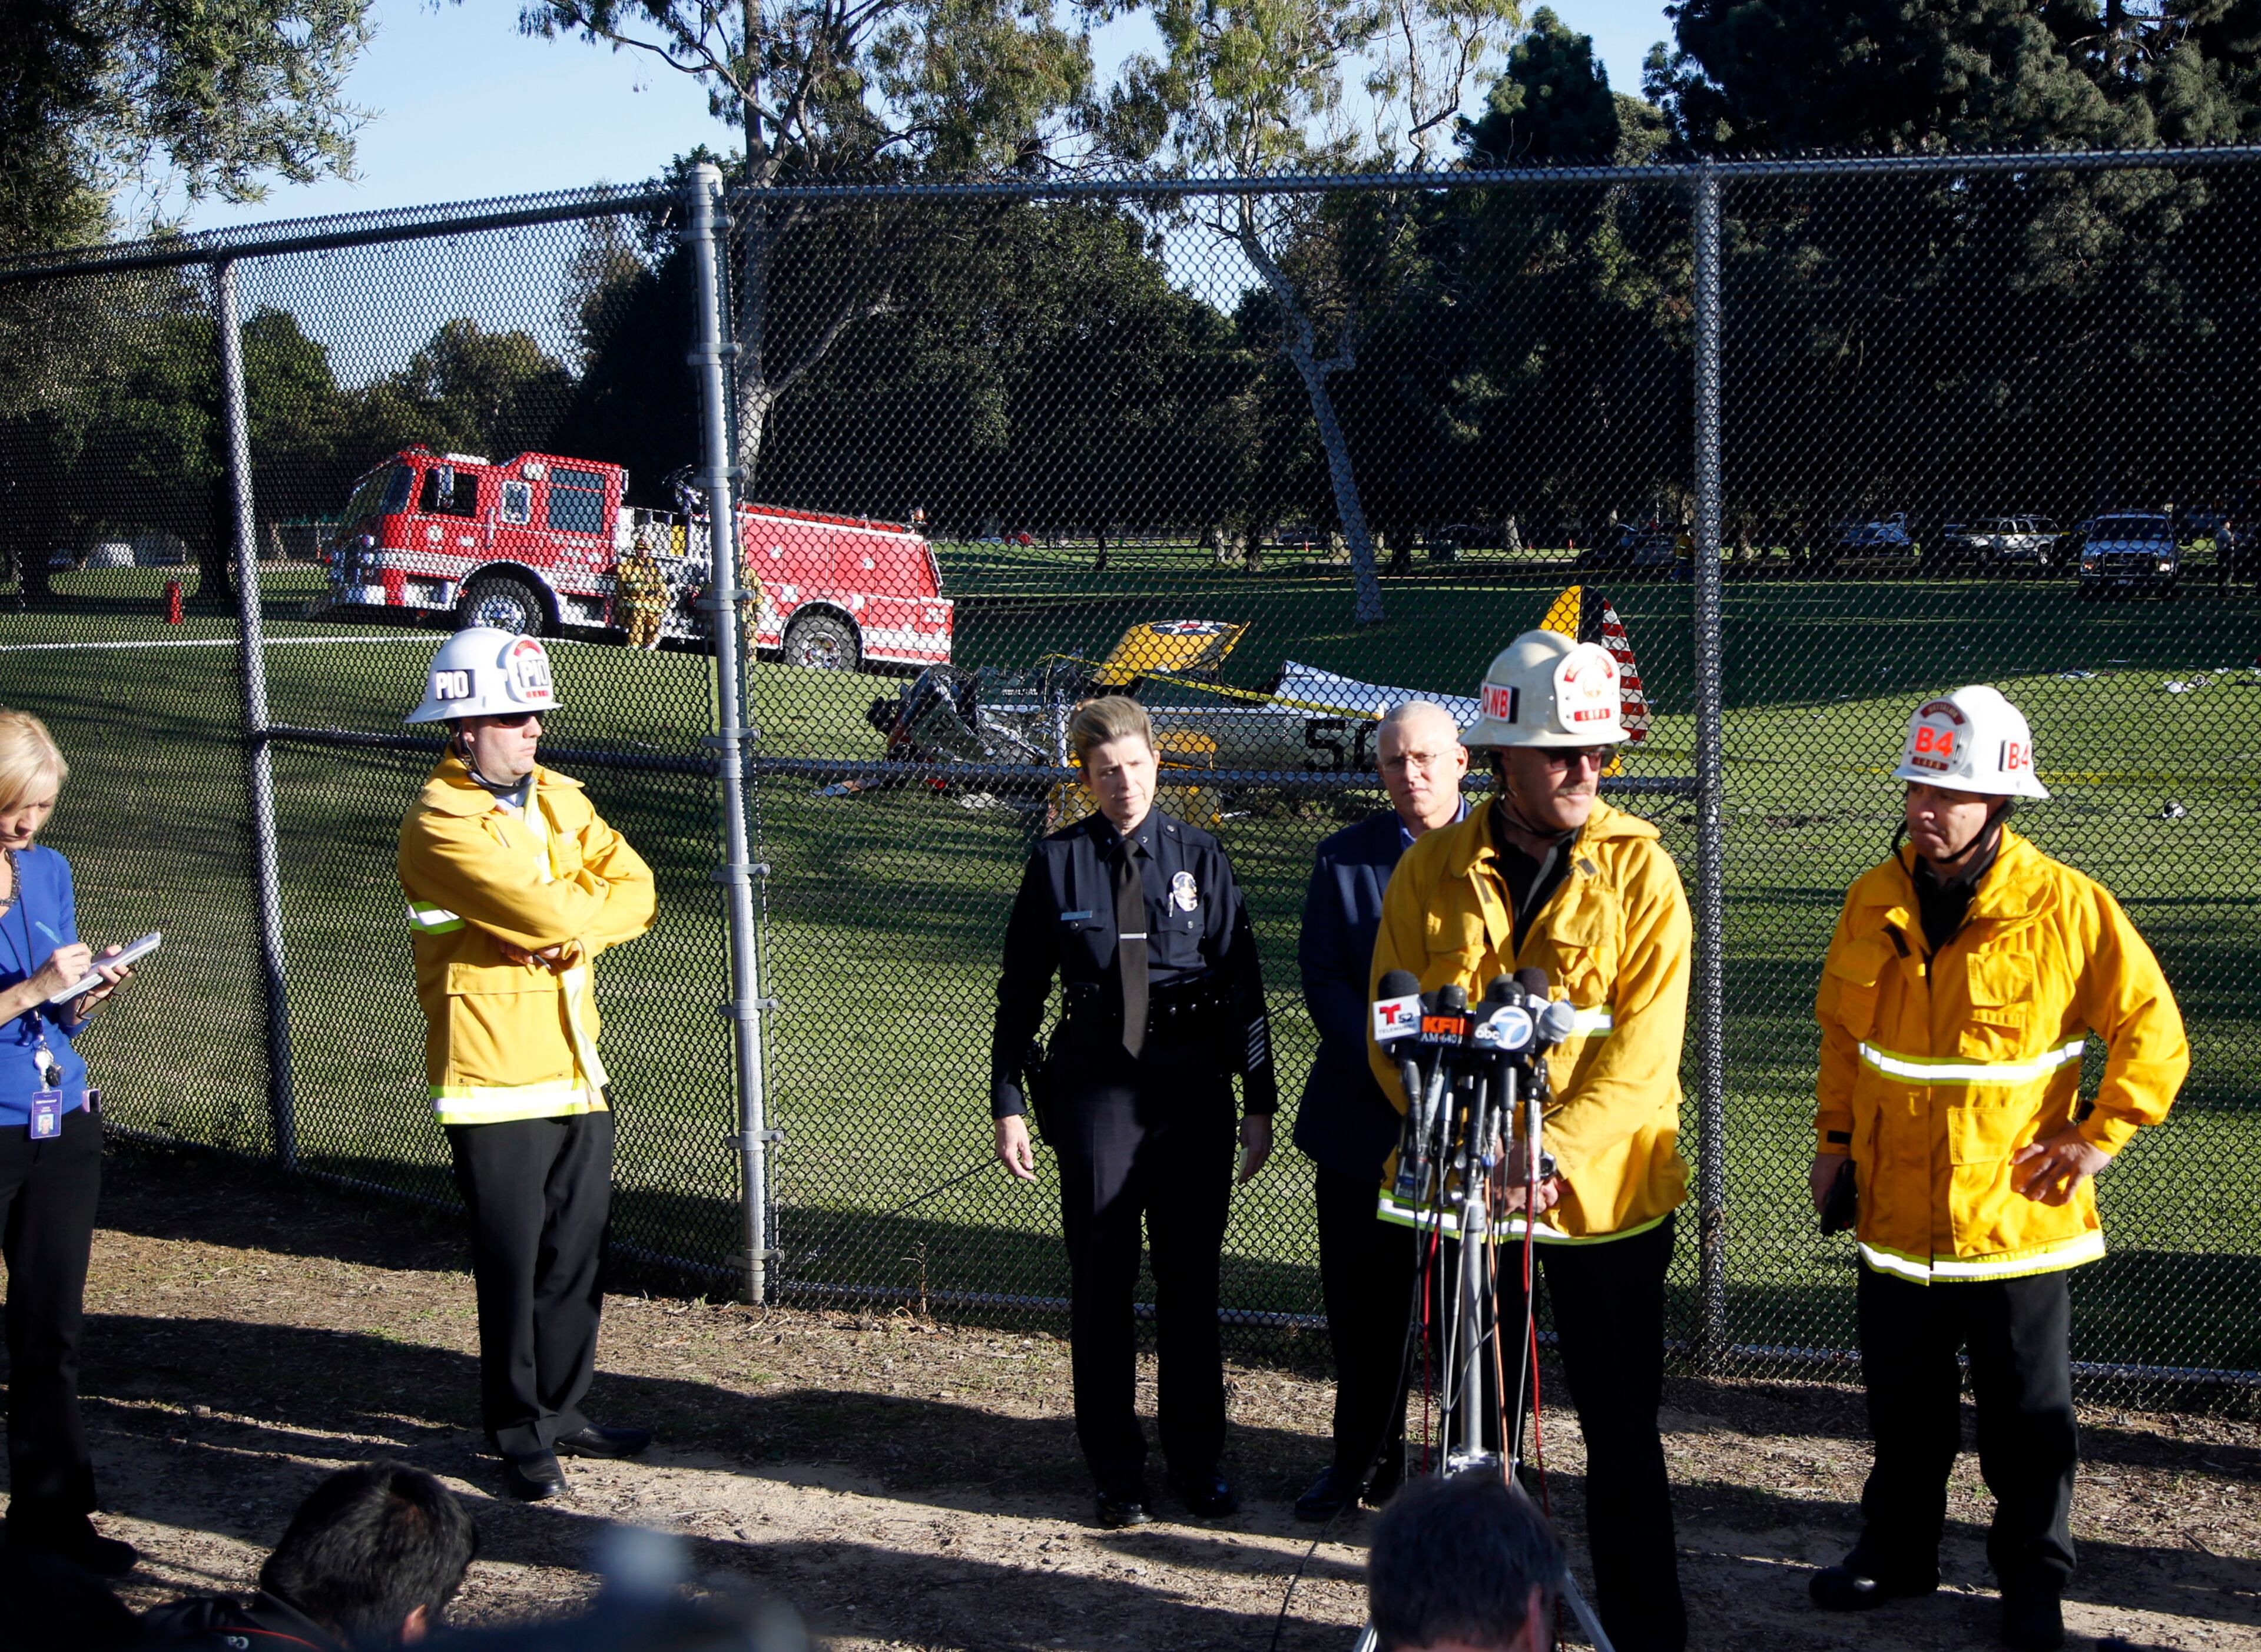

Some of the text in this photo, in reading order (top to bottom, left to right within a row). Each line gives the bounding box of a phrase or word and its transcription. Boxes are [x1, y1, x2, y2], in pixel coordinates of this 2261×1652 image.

[436, 671, 469, 700] PIO
[518, 659, 549, 688] PIO
[1915, 726, 1955, 758] B4
[2007, 742, 2030, 769] B4
[1420, 1033, 1438, 1043] AM
[1422, 1016, 1460, 1034] KFI
[1475, 1028, 1500, 1040] abc
[1490, 1016, 1531, 1049] 7
